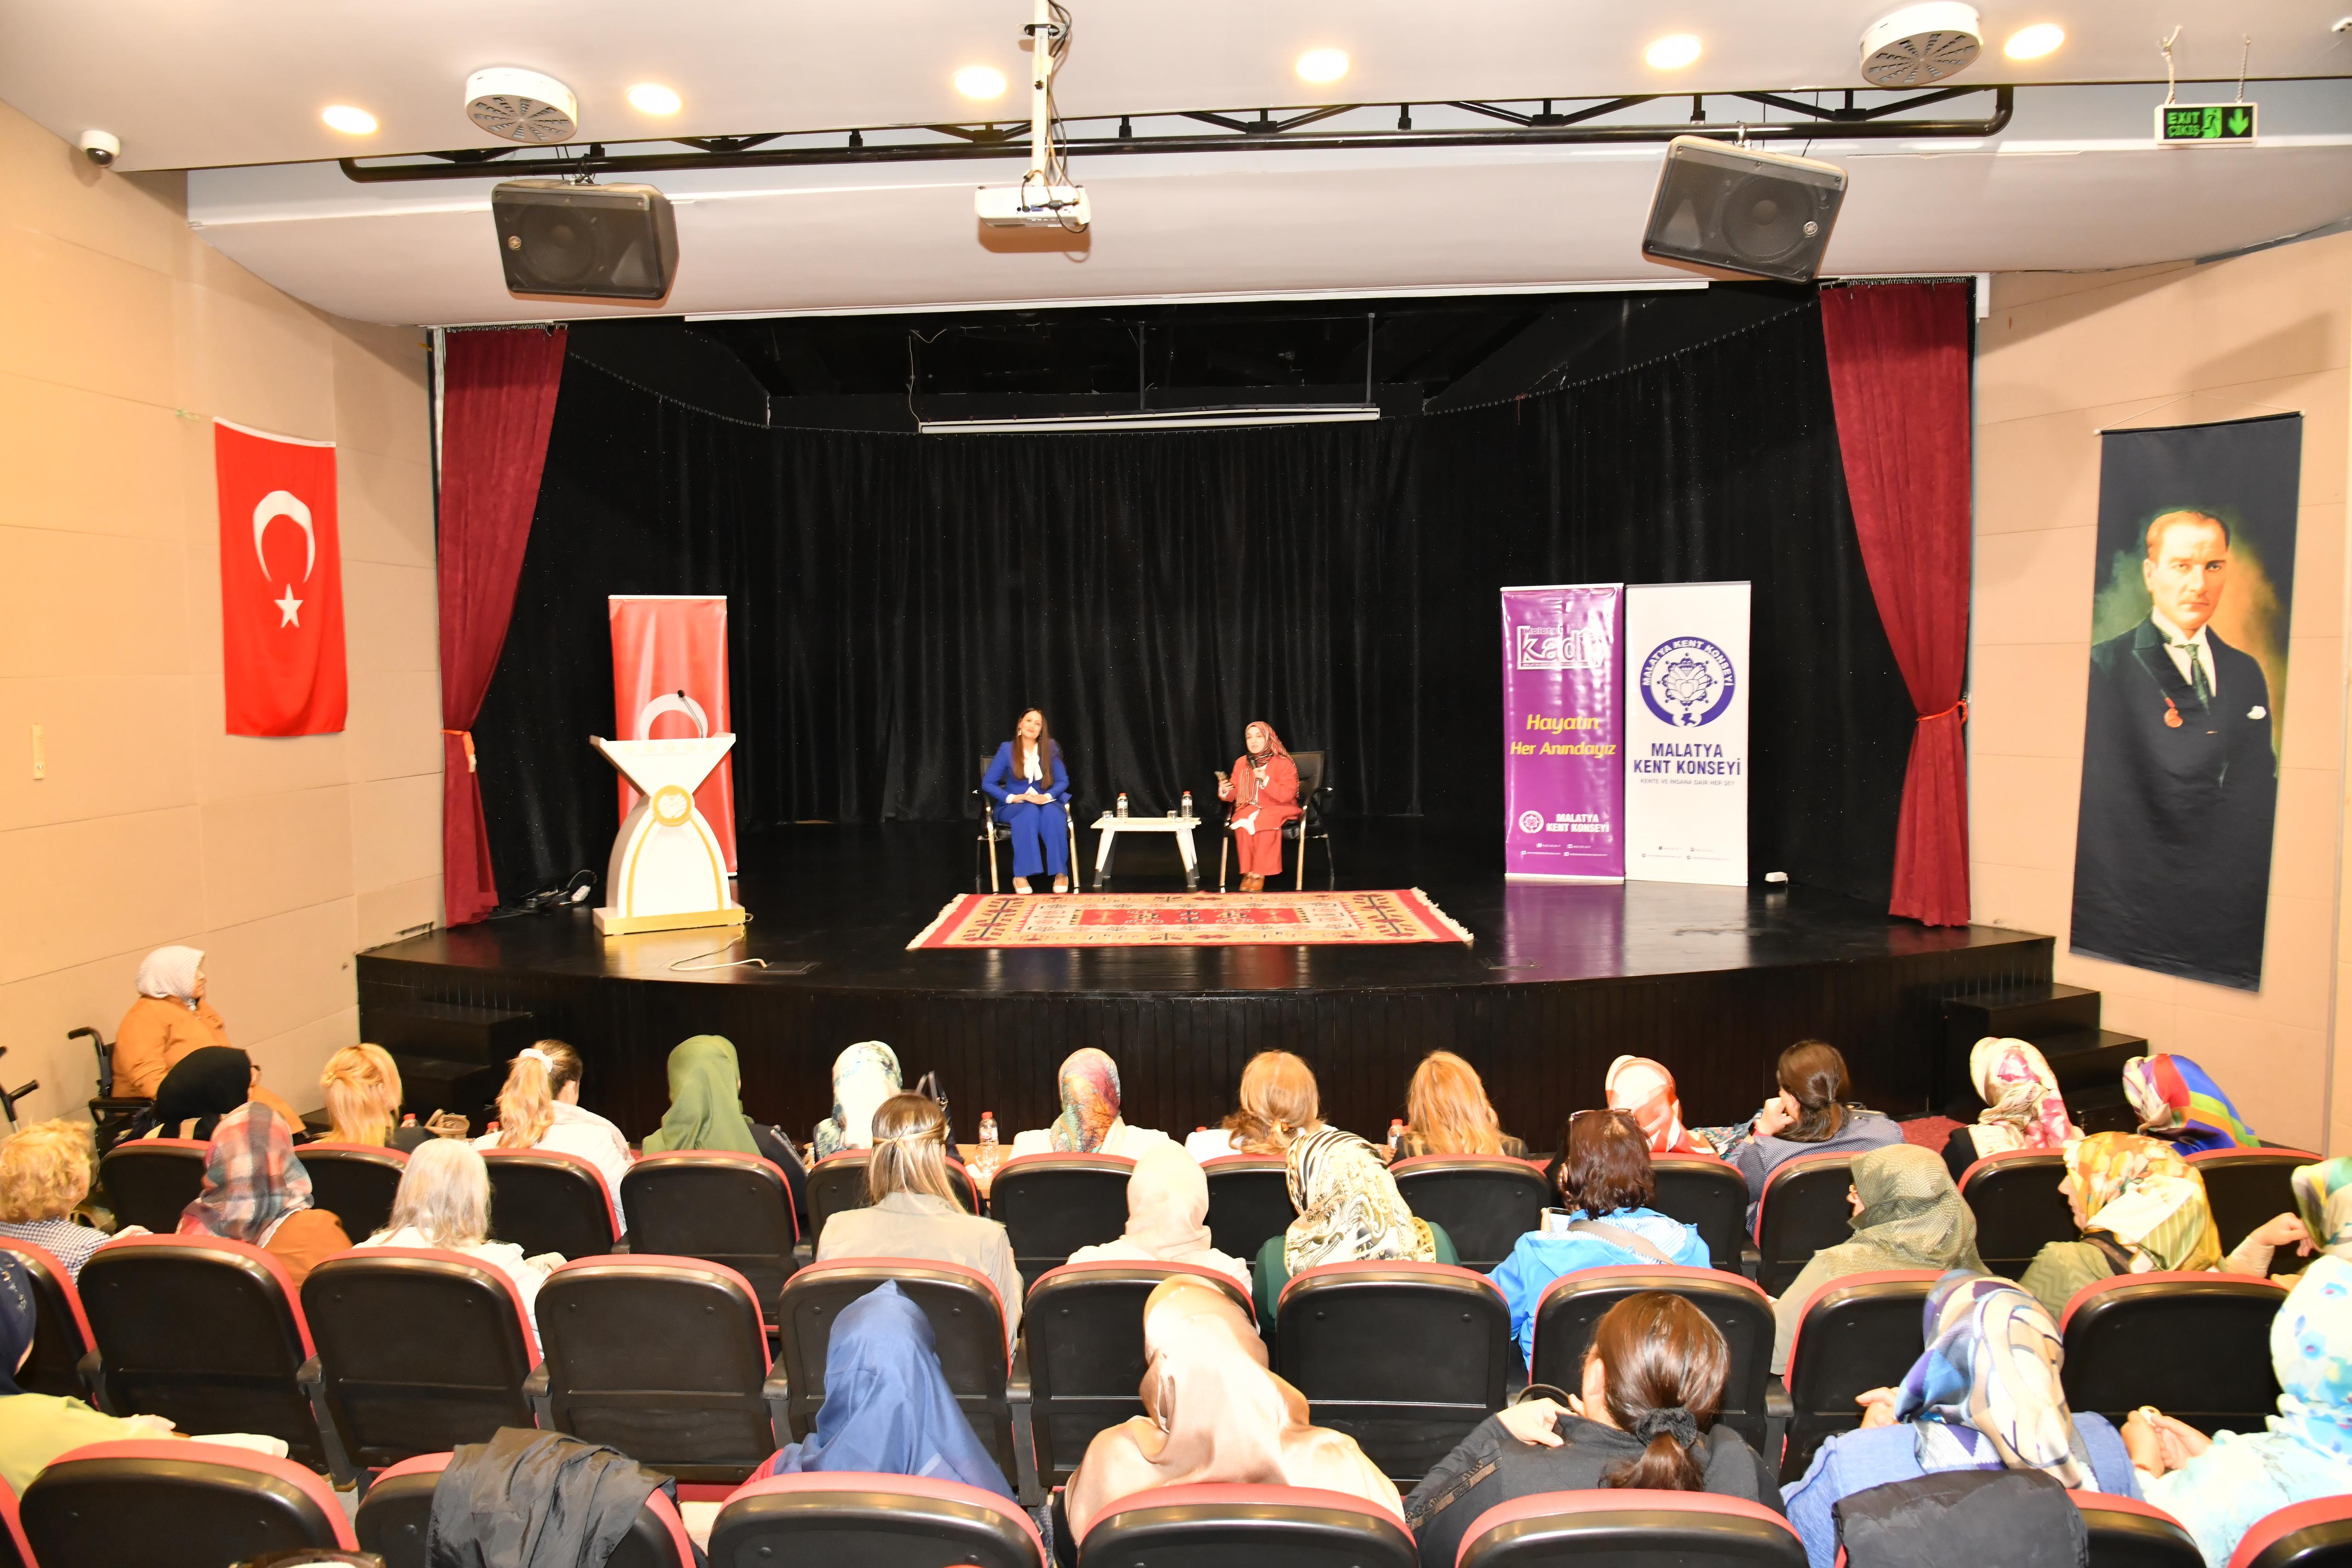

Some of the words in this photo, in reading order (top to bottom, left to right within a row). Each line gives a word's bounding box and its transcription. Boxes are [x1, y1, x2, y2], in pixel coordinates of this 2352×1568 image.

[2167, 111, 2200, 124] EXIT
[1642, 645, 1673, 686] MALATYA
[1672, 639, 1705, 649] KENT
[1526, 714, 1600, 734] Hayatın
[1510, 741, 1537, 755] Her
[1538, 741, 1617, 759] Anındayız
[1651, 743, 1724, 758] MALATYA
[1634, 759, 1672, 773] KENT
[1676, 758, 1741, 775] KONSEYİ
[1555, 813, 1600, 823] MALATYA
[1546, 823, 1570, 832] KENT
